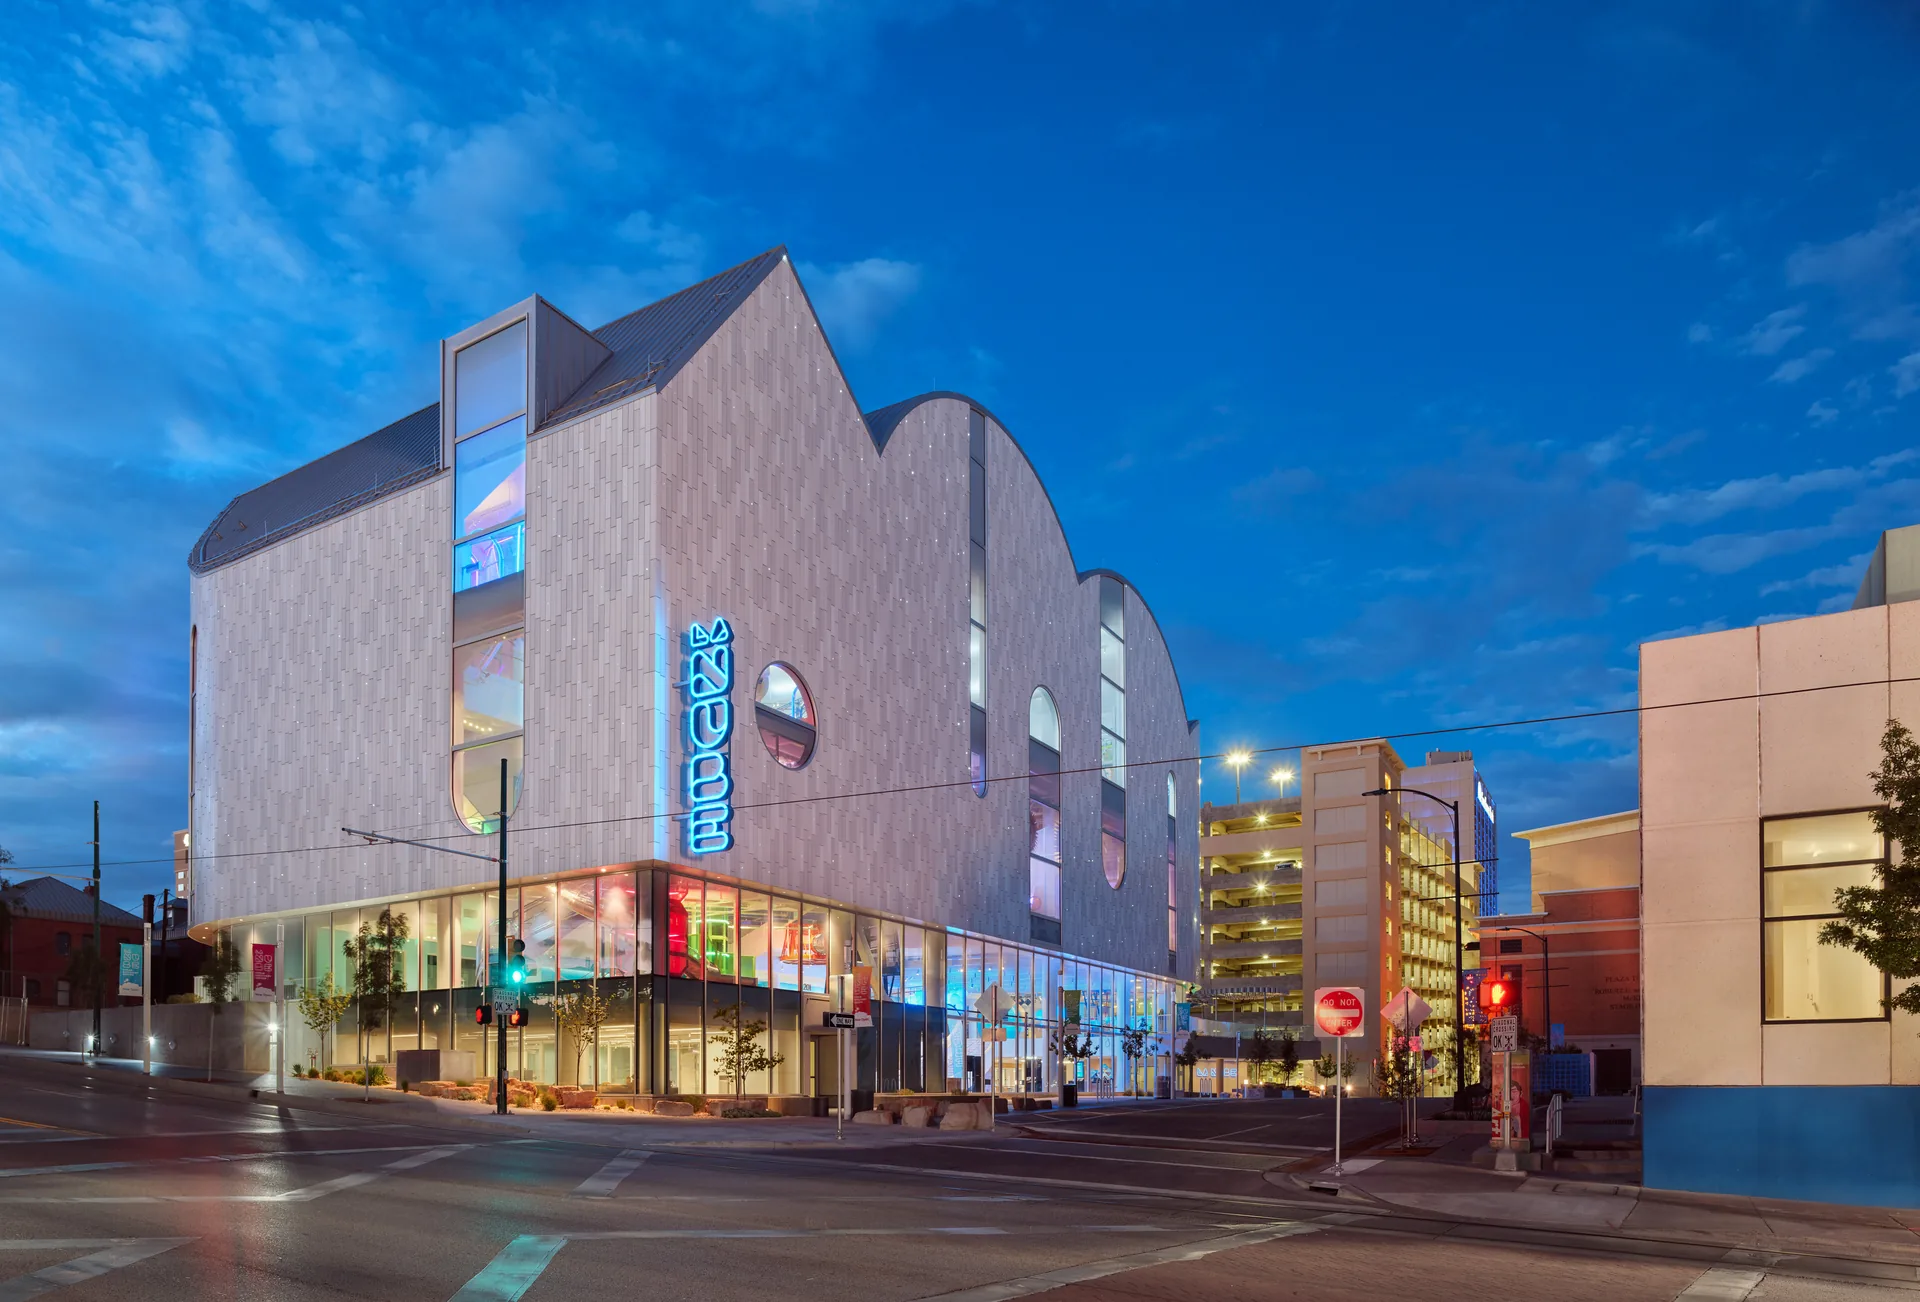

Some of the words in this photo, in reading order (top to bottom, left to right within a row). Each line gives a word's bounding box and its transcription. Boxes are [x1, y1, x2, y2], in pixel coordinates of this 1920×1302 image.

[495, 1002, 503, 1011] OK
[1340, 998, 1356, 1006] NOT
[844, 1017, 852, 1025] WAY
[1493, 1035, 1503, 1048] OK
[1210, 1067, 1238, 1078] NBE
